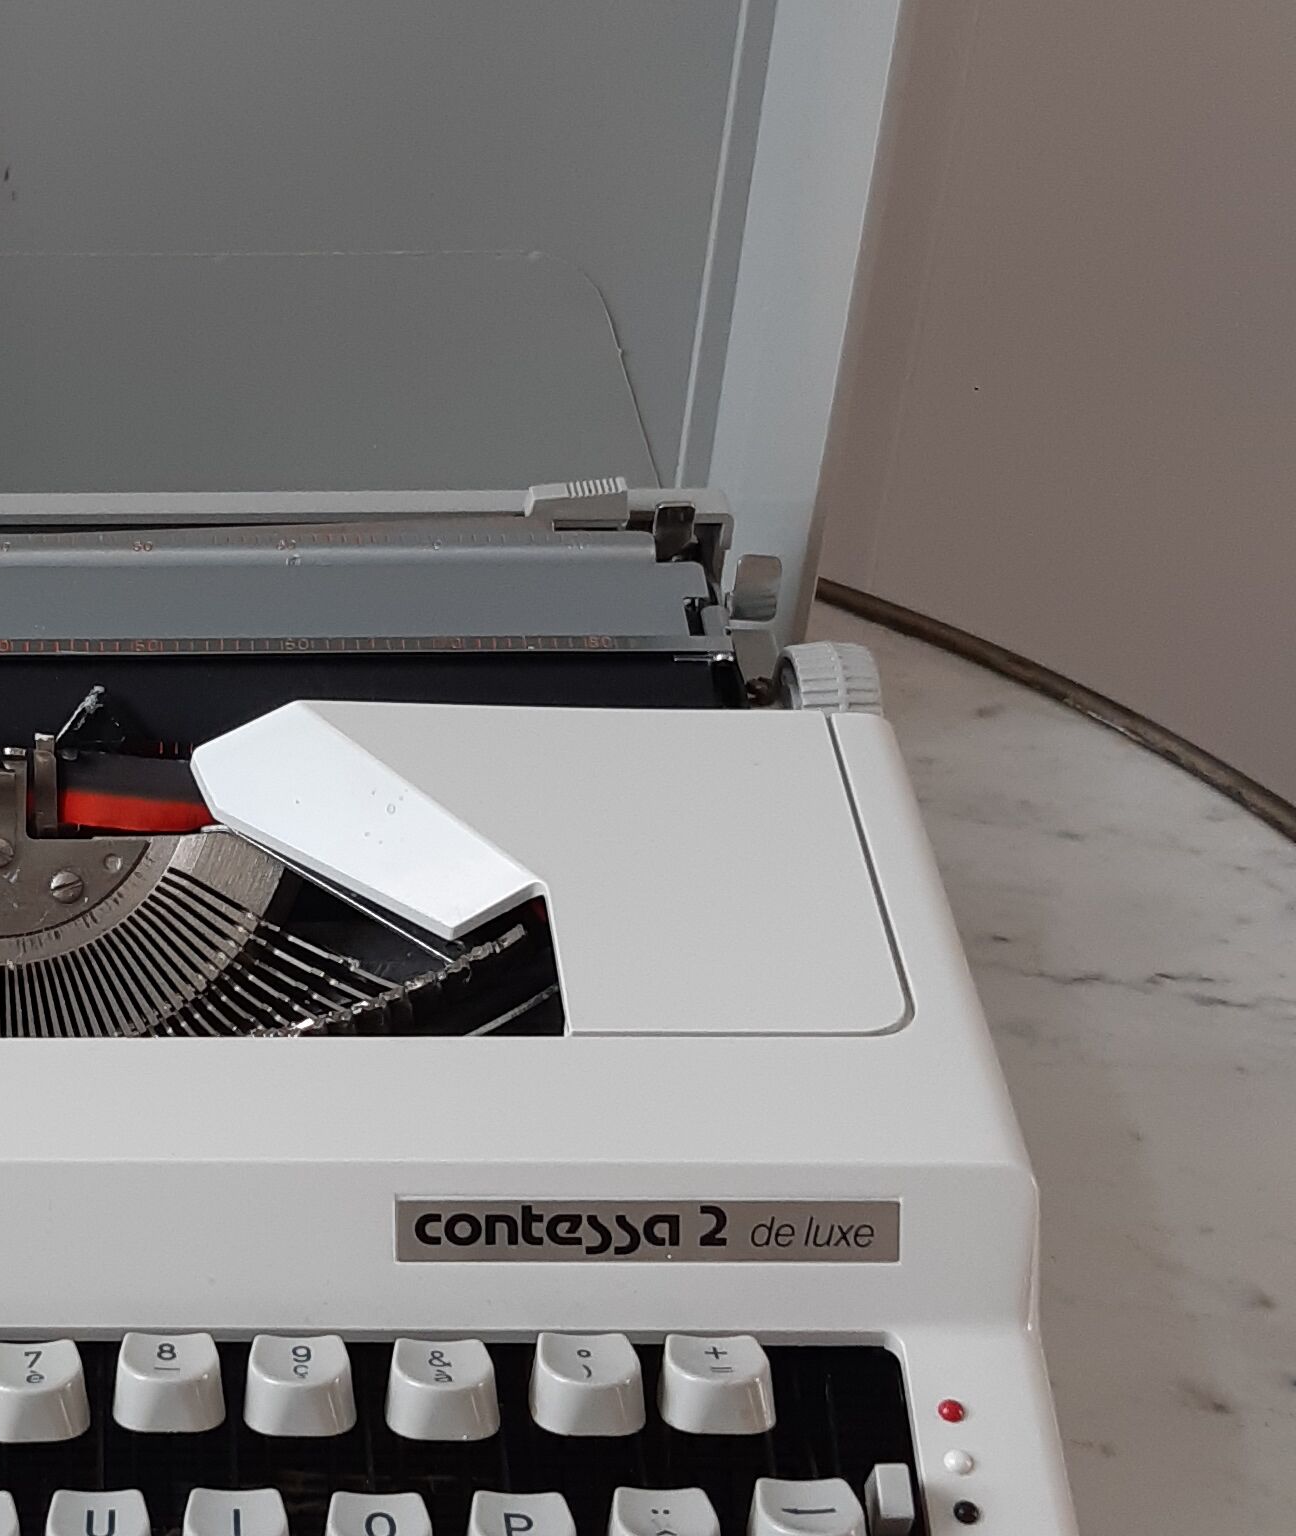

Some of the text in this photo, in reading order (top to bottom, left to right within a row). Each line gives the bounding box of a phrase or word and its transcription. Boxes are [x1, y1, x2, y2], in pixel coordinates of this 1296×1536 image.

[414, 1204, 875, 1256] contessa 2 de luxe
[24, 1350, 43, 1369] 7
[156, 1342, 177, 1361] 8
[291, 1345, 312, 1364] 9
[427, 1350, 452, 1368] &
[25, 1369, 45, 1384] è
